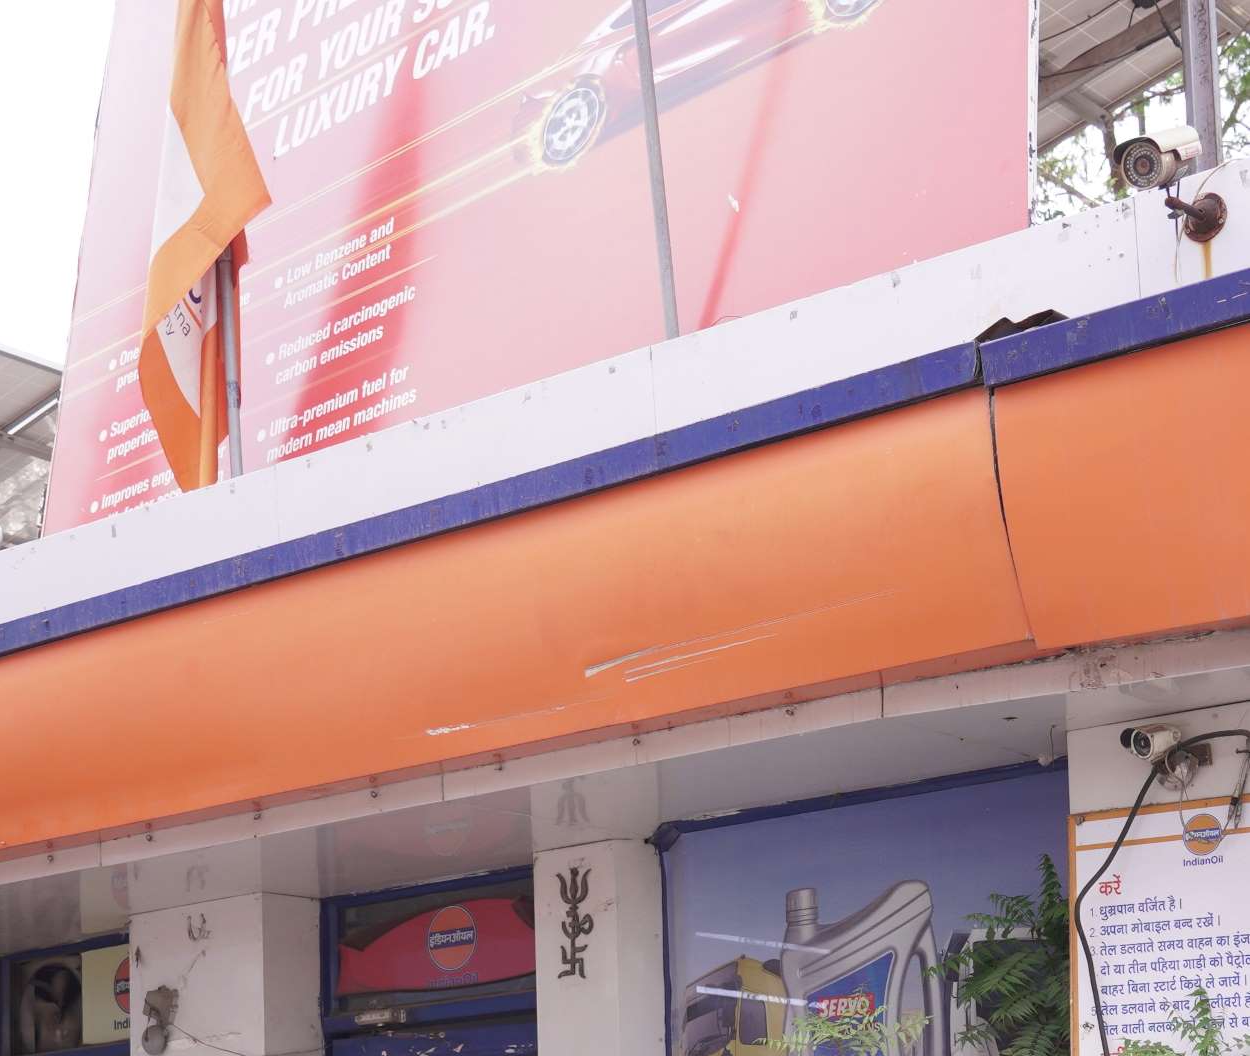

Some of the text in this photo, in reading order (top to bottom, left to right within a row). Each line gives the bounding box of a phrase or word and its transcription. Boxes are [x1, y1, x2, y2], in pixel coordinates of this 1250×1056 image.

[244, 53, 308, 121] FOR
[318, 0, 408, 79] YOUR
[273, 45, 408, 158] LUXURY
[412, 1, 496, 80] CAR.
[283, 245, 392, 309] Aromatic Content
[287, 217, 395, 284] Low Benzene and
[275, 326, 384, 384] carbon emissions
[278, 286, 416, 360] Reduced carcinogenic
[267, 388, 417, 464] modern mean machines
[270, 366, 410, 437] Ultra-premium fuel for
[101, 477, 150, 510] Improves
[1097, 873, 1122, 896] करें
[1183, 855, 1224, 867] IndianOil
[1157, 939, 1184, 953] समय
